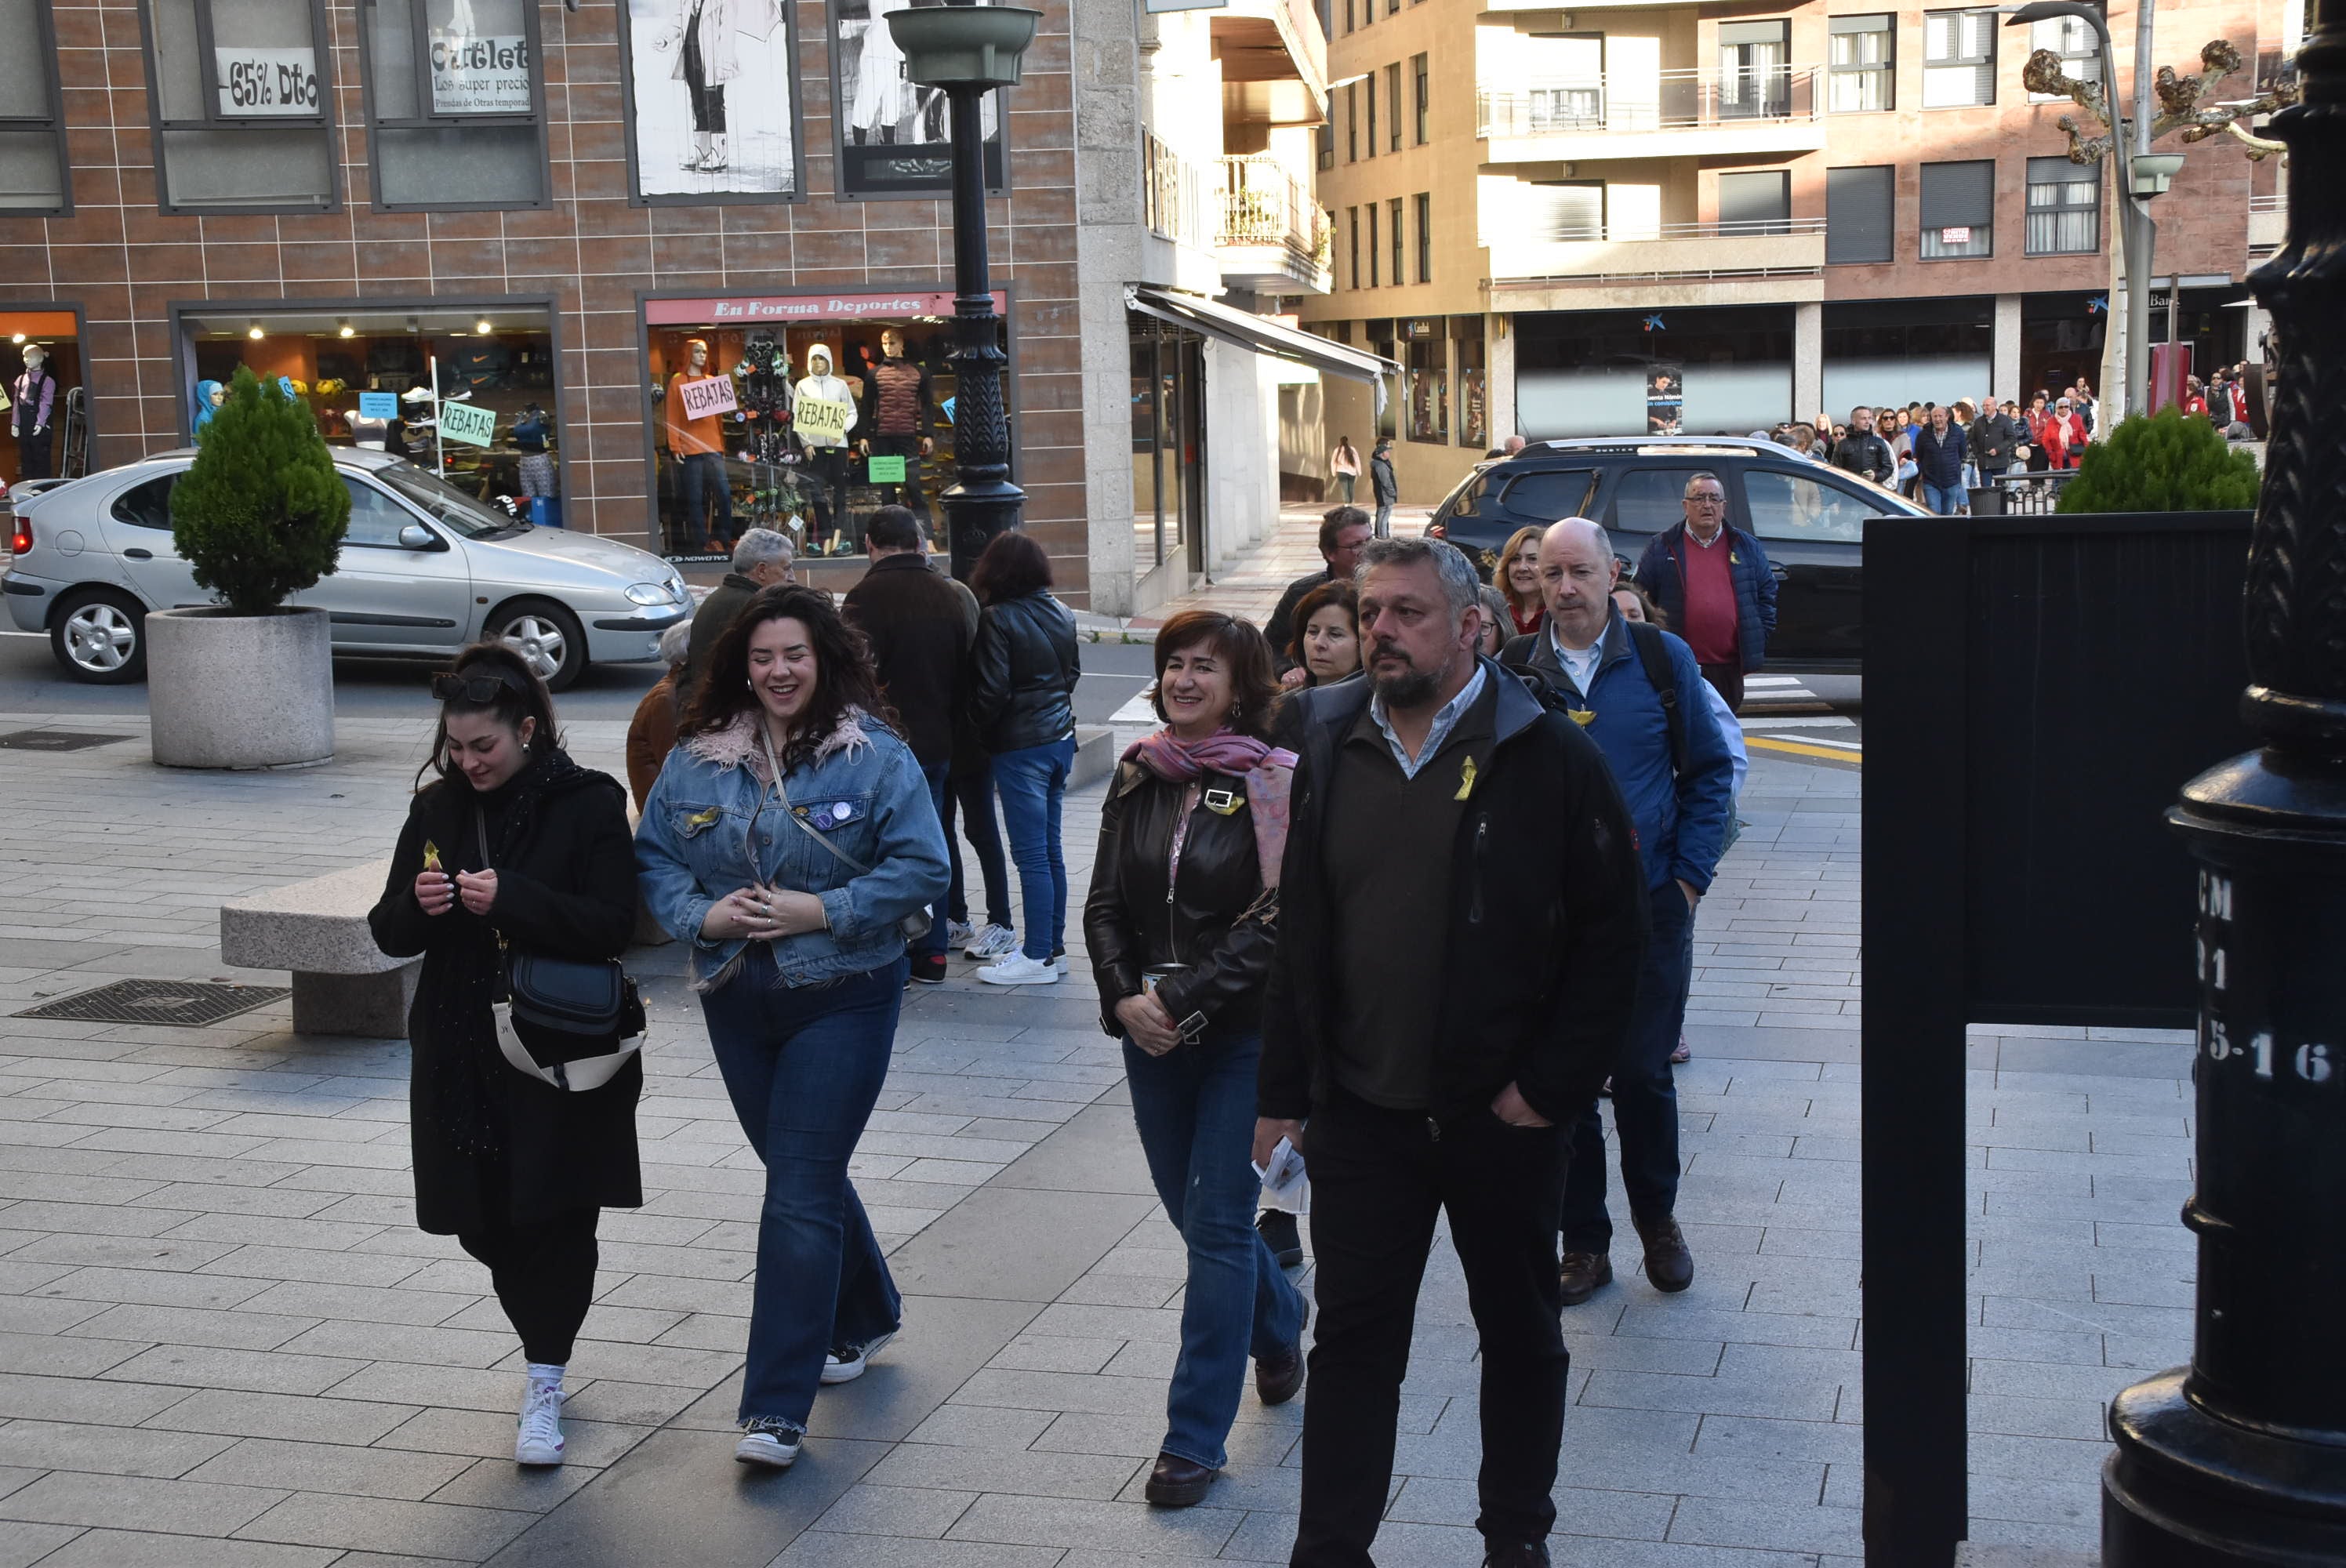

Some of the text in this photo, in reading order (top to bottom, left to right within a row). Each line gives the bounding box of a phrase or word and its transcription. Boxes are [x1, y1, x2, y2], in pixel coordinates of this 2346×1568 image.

[218, 58, 318, 107] -65% Dto
[434, 75, 454, 92] Los
[459, 79, 490, 94] super
[474, 98, 494, 107] Otras
[714, 299, 921, 317] En Forma Deportes
[684, 380, 733, 412] REBAJAS
[444, 406, 493, 438] REBAJAS
[797, 401, 845, 430] REBAJAS
